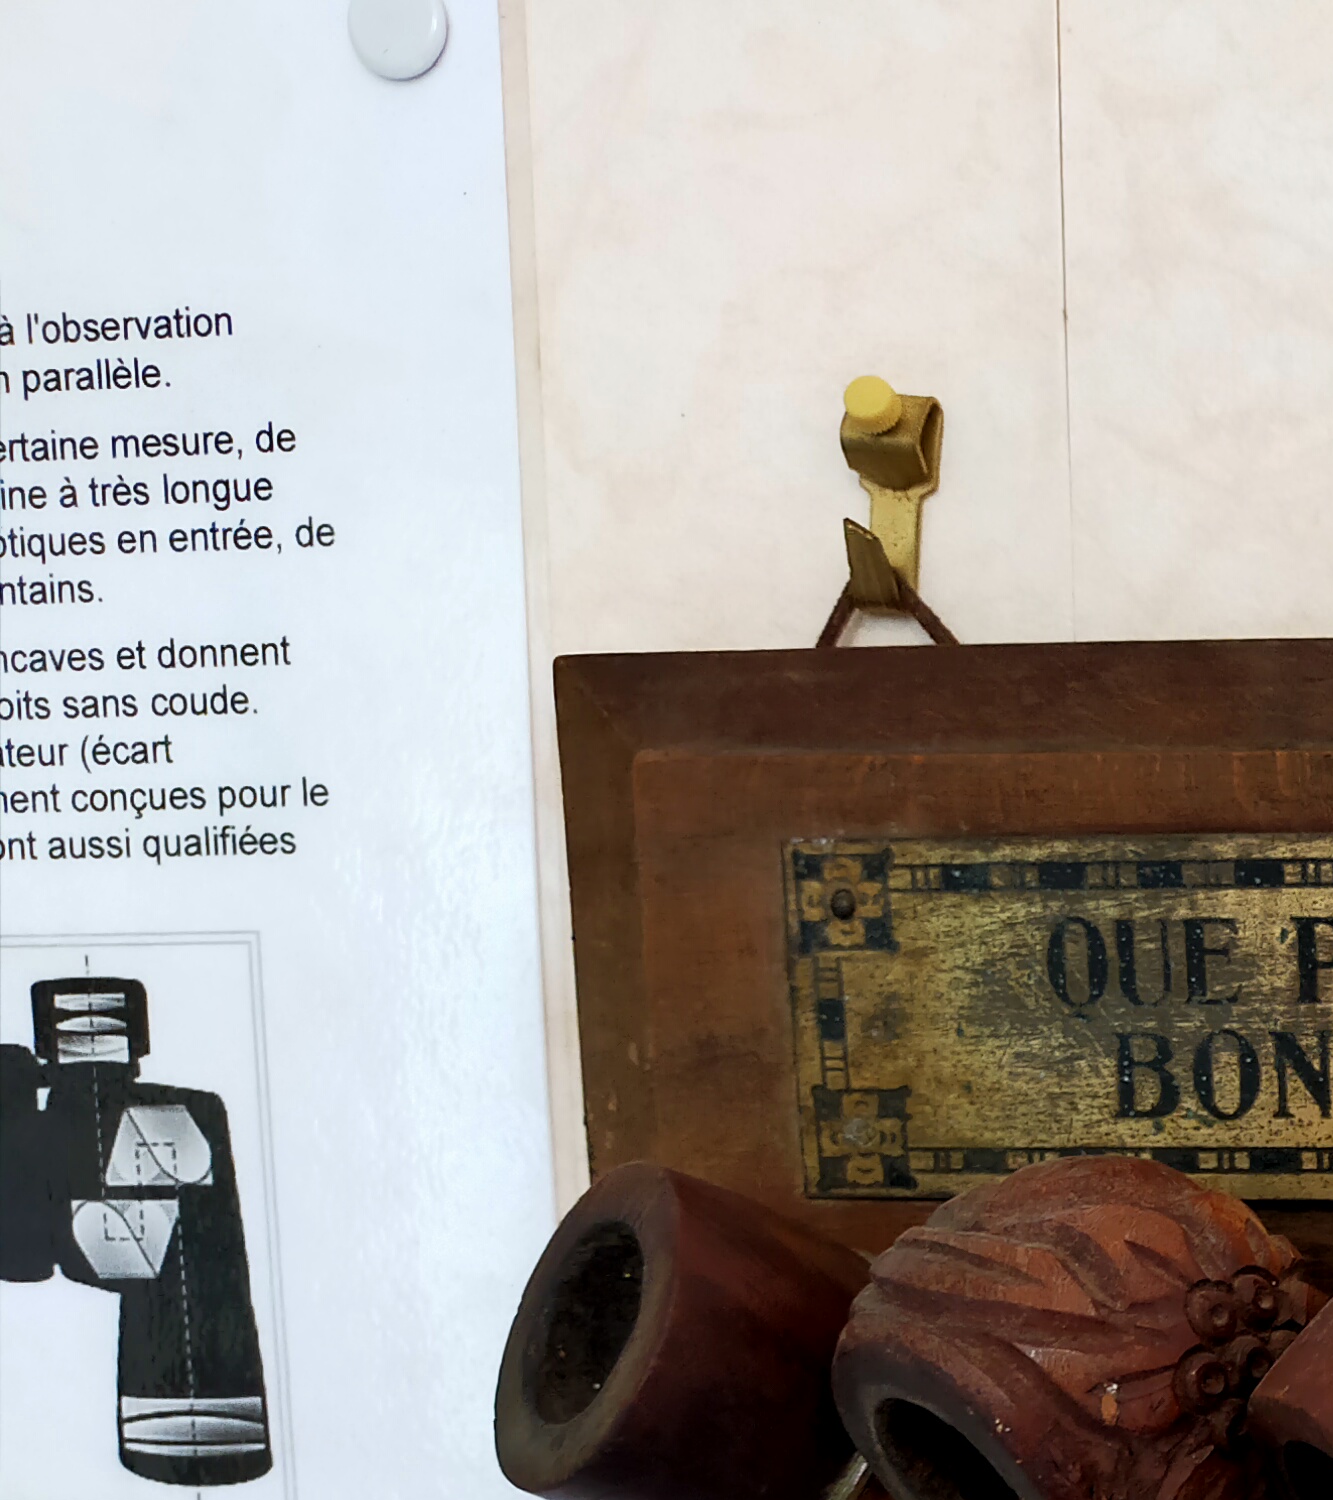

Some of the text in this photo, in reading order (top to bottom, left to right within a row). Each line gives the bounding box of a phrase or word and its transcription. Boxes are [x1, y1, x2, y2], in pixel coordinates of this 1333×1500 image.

[0, 305, 233, 347] à l'observation
[21, 356, 172, 402] parallèle.
[110, 430, 243, 461] mesure,
[255, 420, 297, 454] de
[58, 475, 79, 509] à
[87, 473, 151, 508] très
[162, 472, 274, 512] longue
[117, 529, 158, 555] en
[168, 517, 282, 555] entrée,
[294, 515, 336, 549] de
[0, 572, 103, 607] ntains.
[116, 639, 148, 671] et
[156, 635, 292, 670] donnent
[62, 693, 139, 720] sans
[150, 683, 258, 717] coude.
[80, 733, 174, 774] (écart
[70, 786, 207, 820] conçues
[217, 784, 292, 818] pour
[301, 775, 330, 807] le
[47, 827, 132, 860] aussi
[142, 824, 297, 866] qualifiées
[1046, 914, 1242, 1018] QUE
